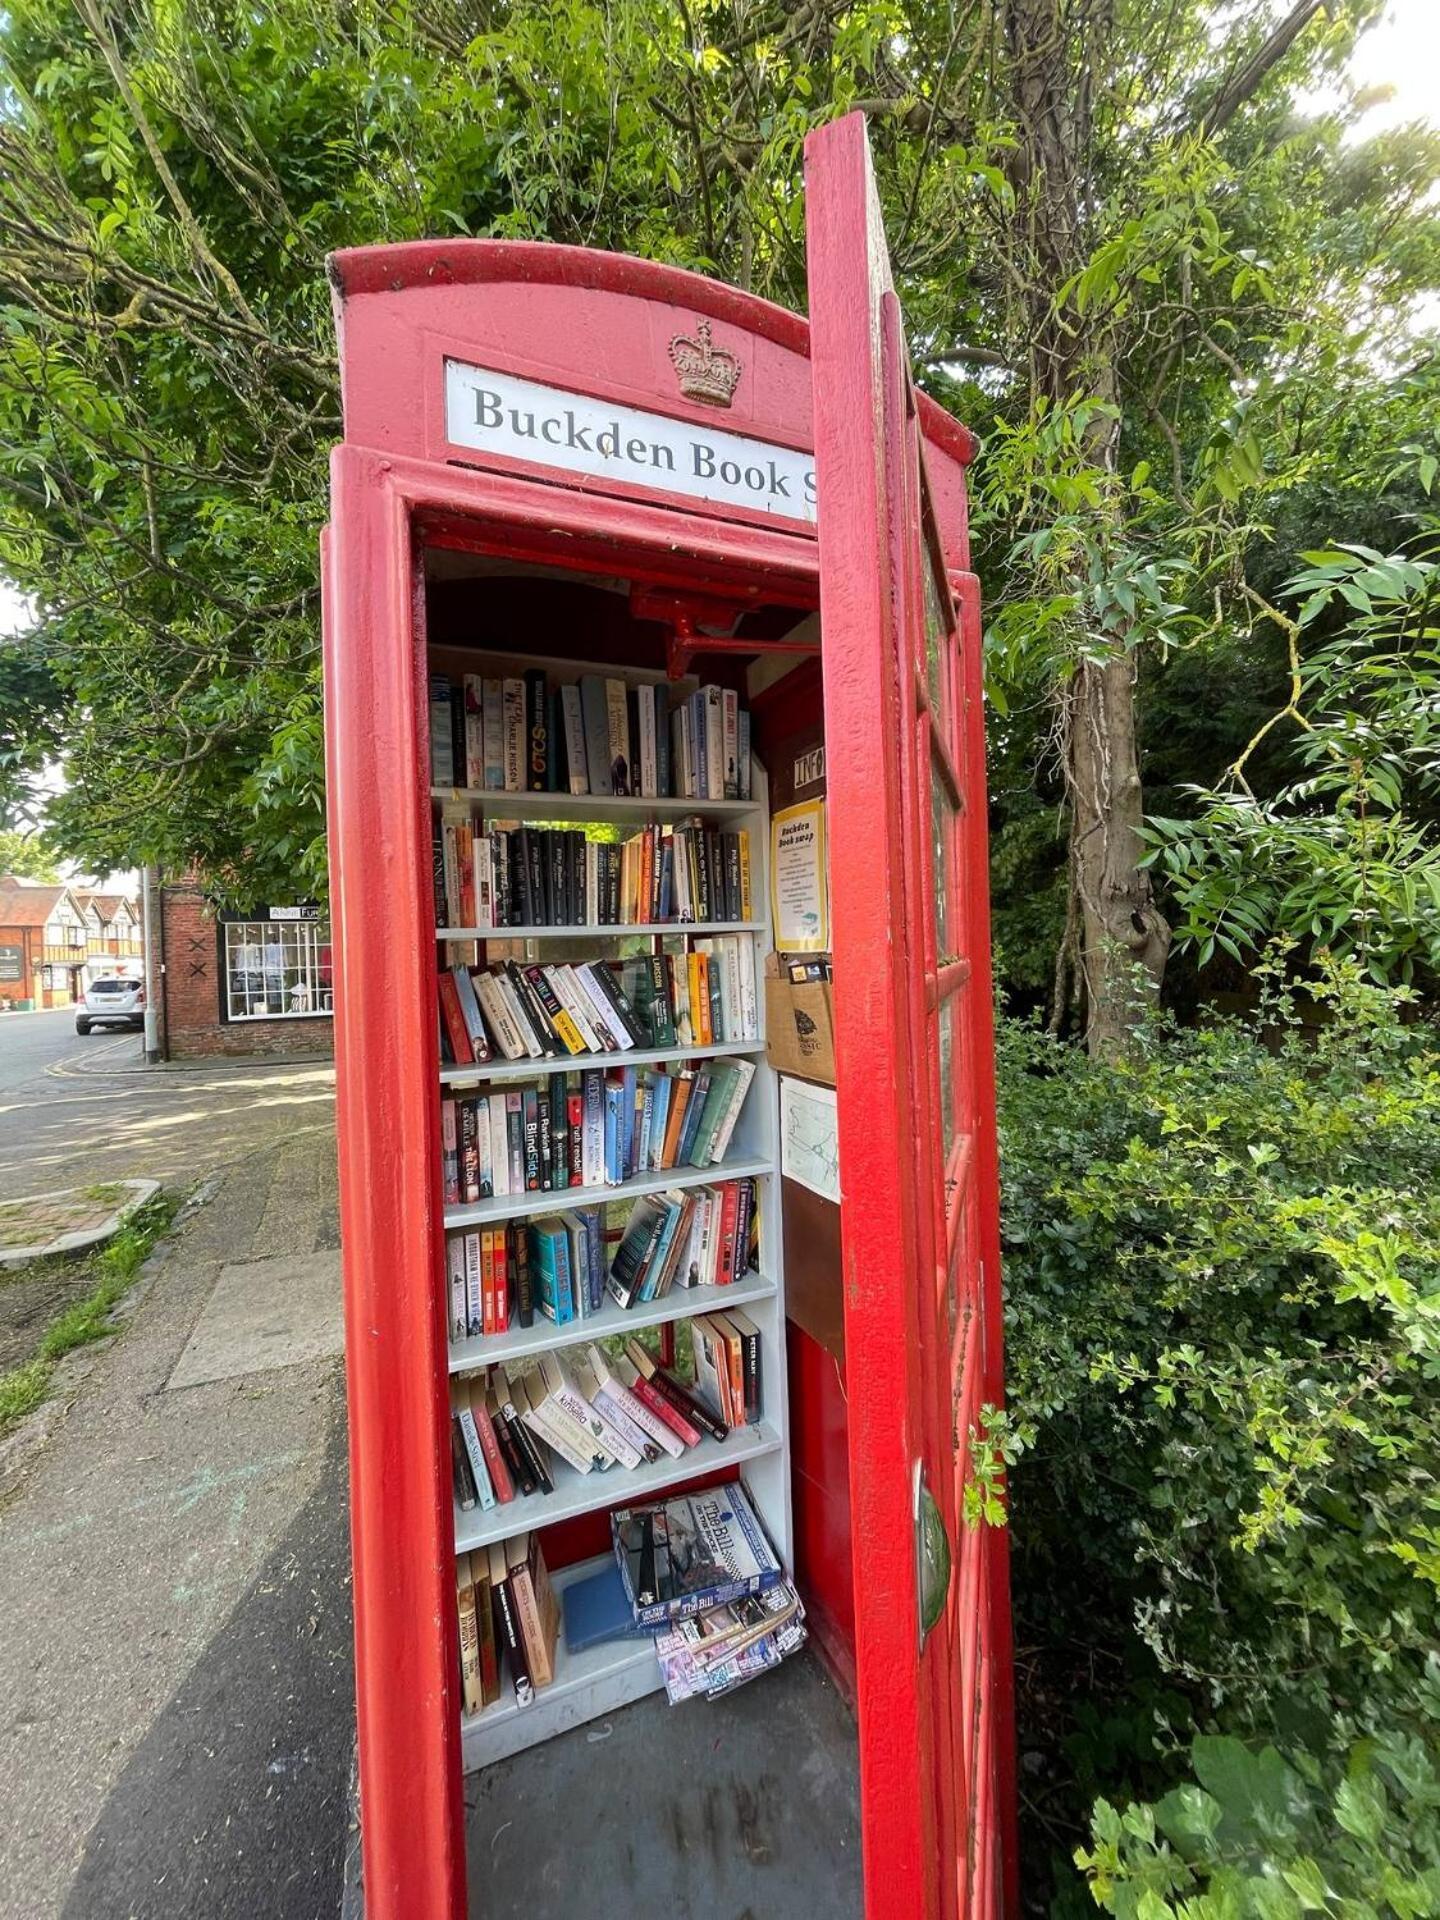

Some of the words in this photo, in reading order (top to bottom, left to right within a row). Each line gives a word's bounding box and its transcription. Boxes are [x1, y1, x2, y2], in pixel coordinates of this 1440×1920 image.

[472, 387, 677, 471] Buckden
[689, 442, 791, 497] Book
[532, 726, 546, 773] SOLO
[574, 1126, 582, 1143] ruth
[527, 1122, 538, 1177] BlindSide
[574, 1145, 582, 1172] rendell
[702, 1500, 724, 1528] The
[712, 1523, 734, 1552] Bill
[698, 1595, 714, 1611] Bill
